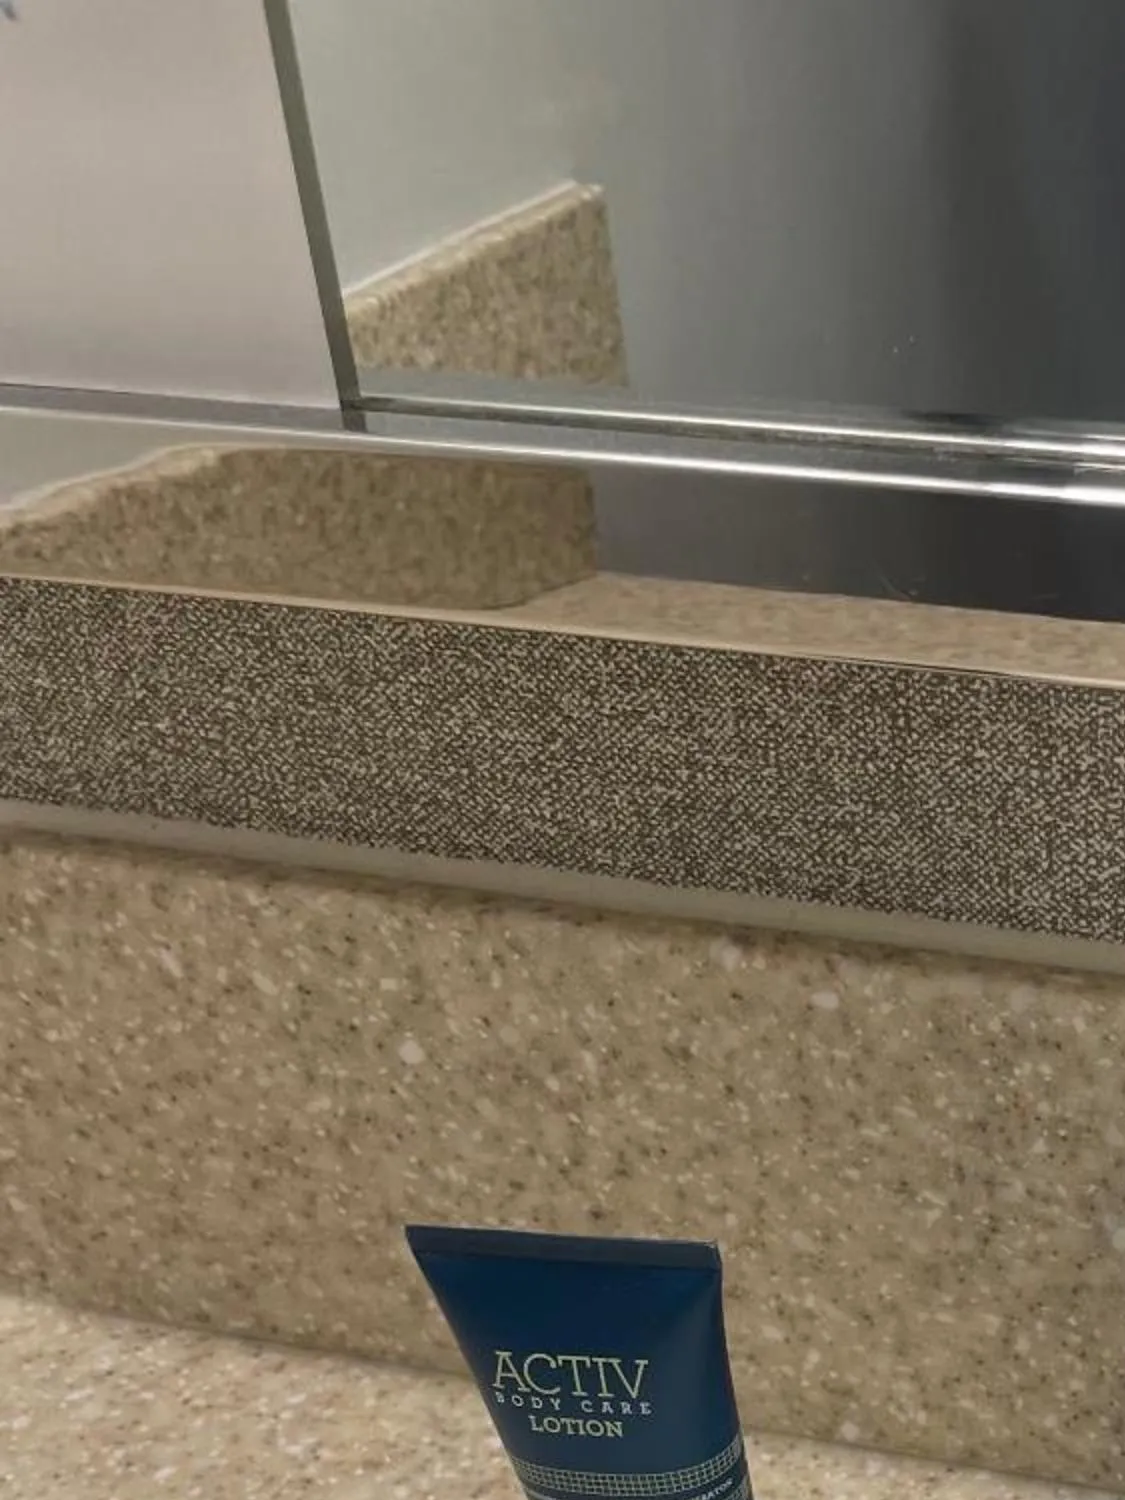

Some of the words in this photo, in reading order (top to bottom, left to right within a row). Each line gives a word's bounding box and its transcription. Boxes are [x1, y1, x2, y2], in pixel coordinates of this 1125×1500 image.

[492, 1351, 649, 1399] ACTIV
[495, 1391, 561, 1411] BODY
[581, 1401, 652, 1415] CARE
[528, 1414, 625, 1438] LOTION
